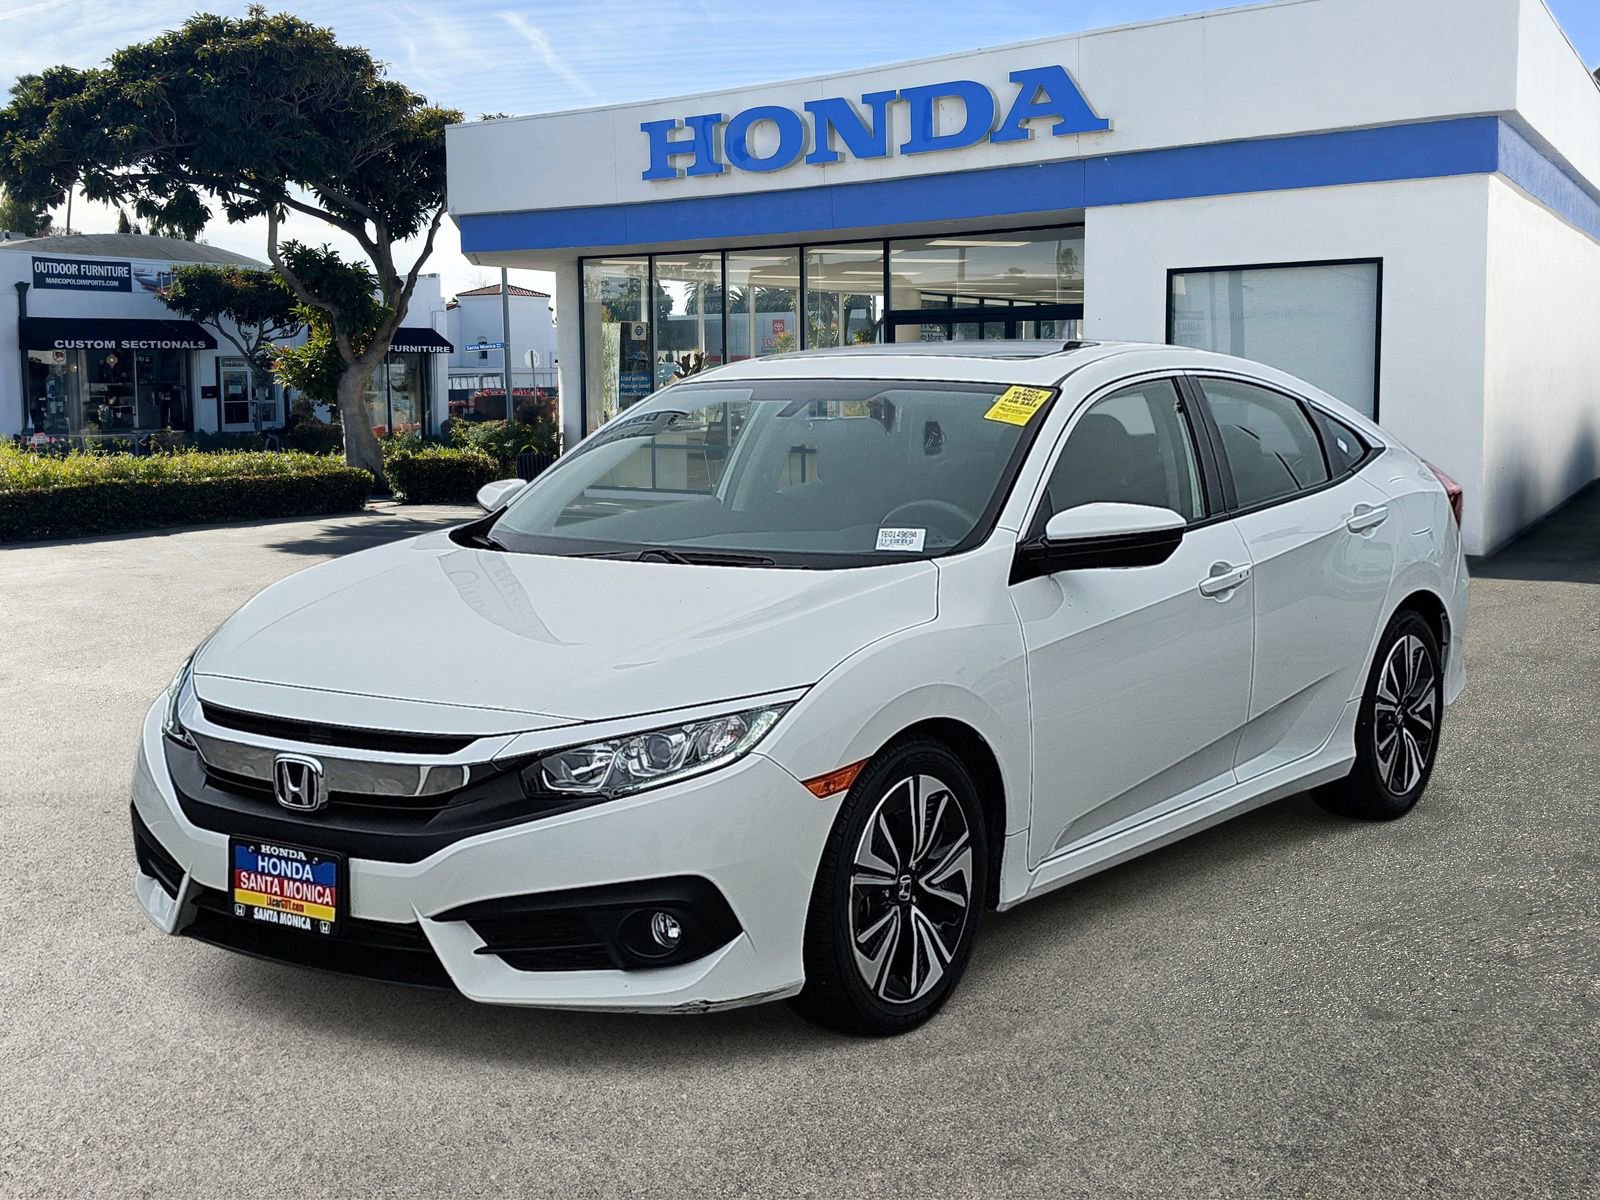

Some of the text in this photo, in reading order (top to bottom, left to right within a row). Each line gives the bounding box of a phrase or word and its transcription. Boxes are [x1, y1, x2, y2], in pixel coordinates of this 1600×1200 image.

[640, 65, 1110, 181] HONDA
[34, 261, 130, 278] OUTDOOR FURNITURE
[45, 277, 119, 287] MARCOPOLOIMPORTS.COM
[54, 339, 206, 349] CUSTOM SECTIONALS
[388, 344, 450, 353] FURNITURE
[260, 844, 307, 861] HONDA
[257, 855, 313, 882] HONDA
[240, 871, 333, 906] SANTA MONICA
[253, 907, 311, 930] SANTA MONICA
